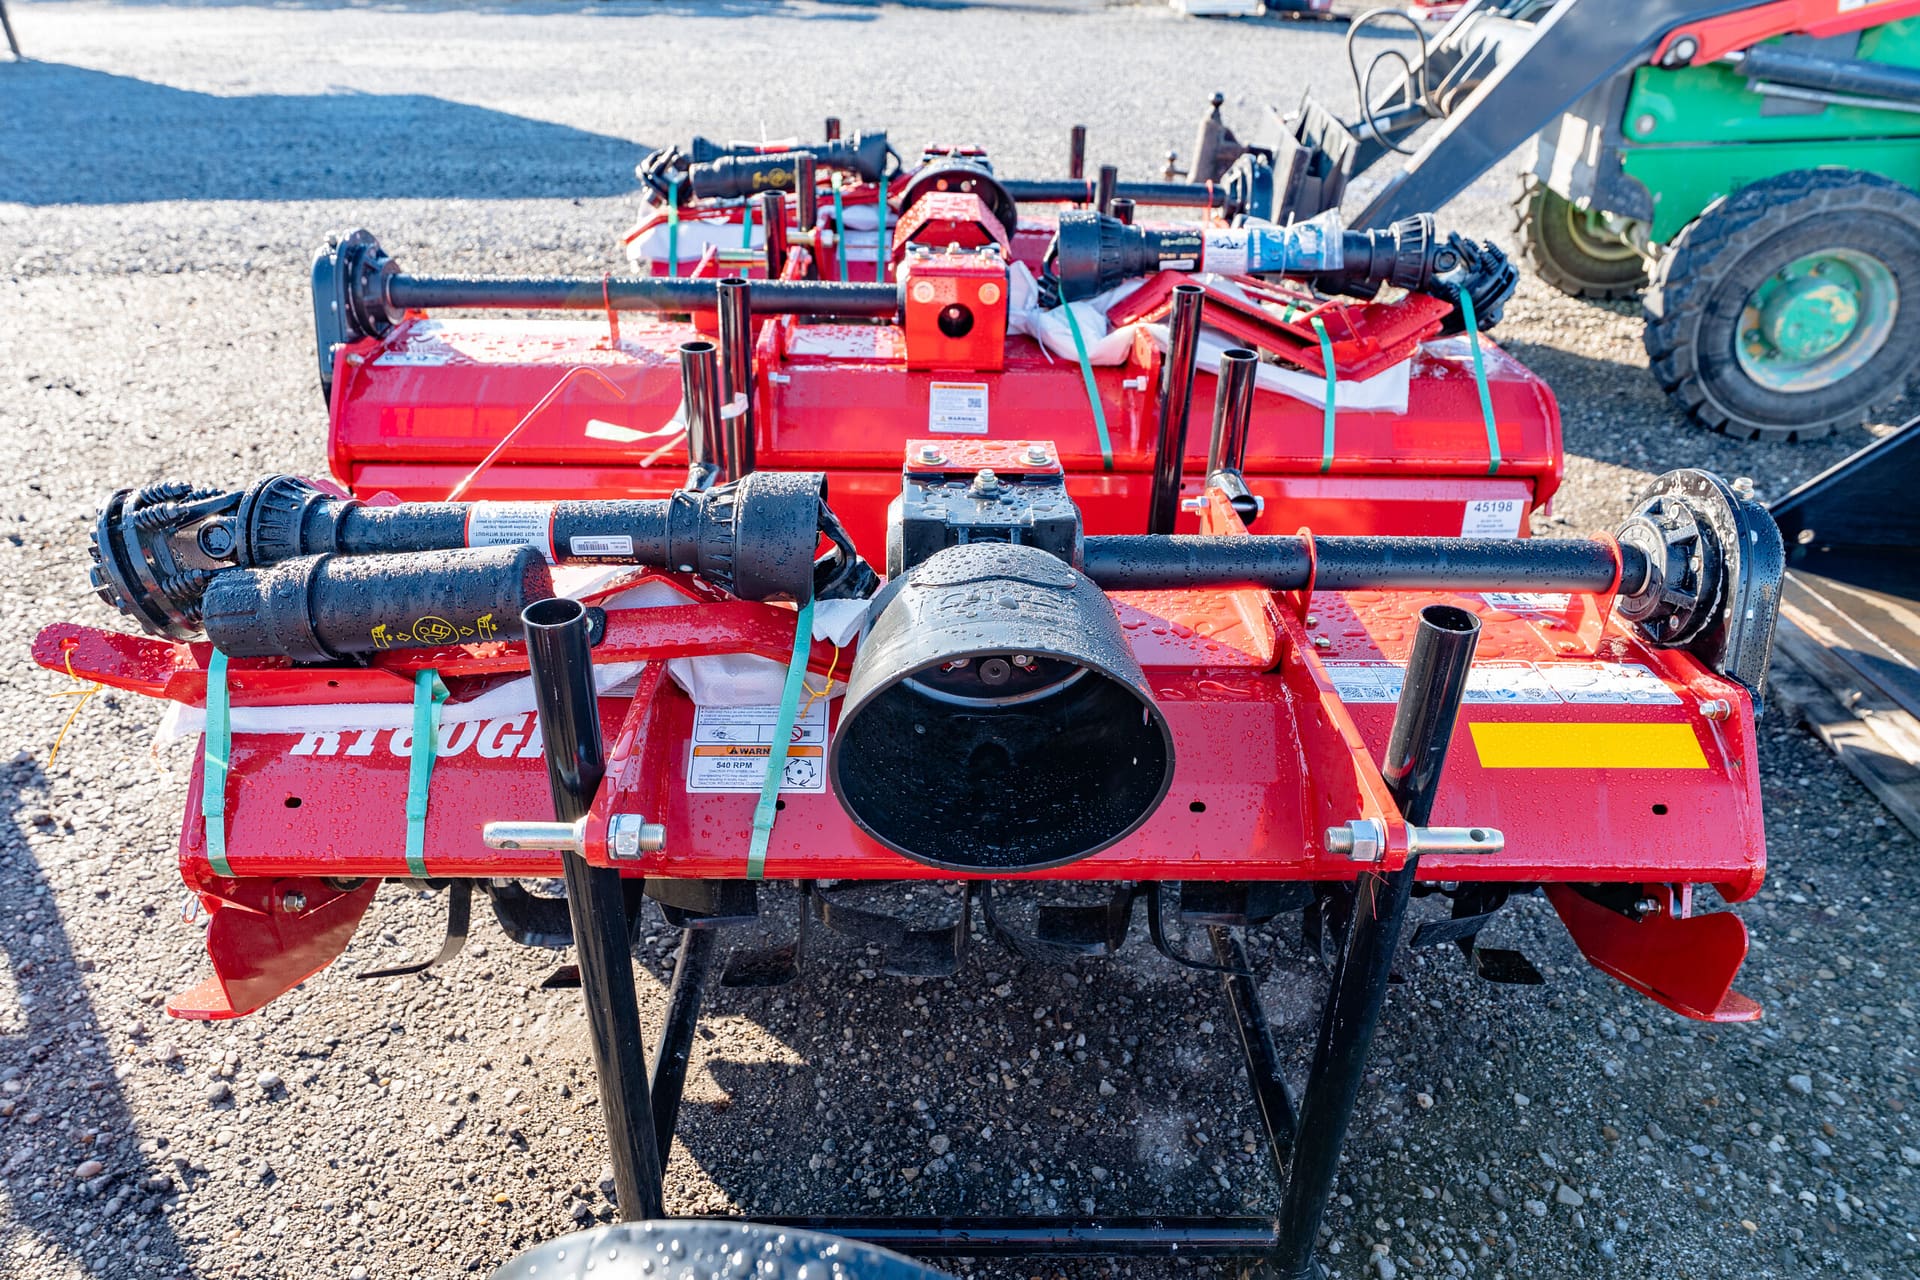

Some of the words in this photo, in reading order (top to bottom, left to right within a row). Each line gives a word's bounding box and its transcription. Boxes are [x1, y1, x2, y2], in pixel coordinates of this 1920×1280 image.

[1474, 502, 1512, 512] 45198
[717, 761, 730, 769] 540
[733, 761, 752, 769] RPM
